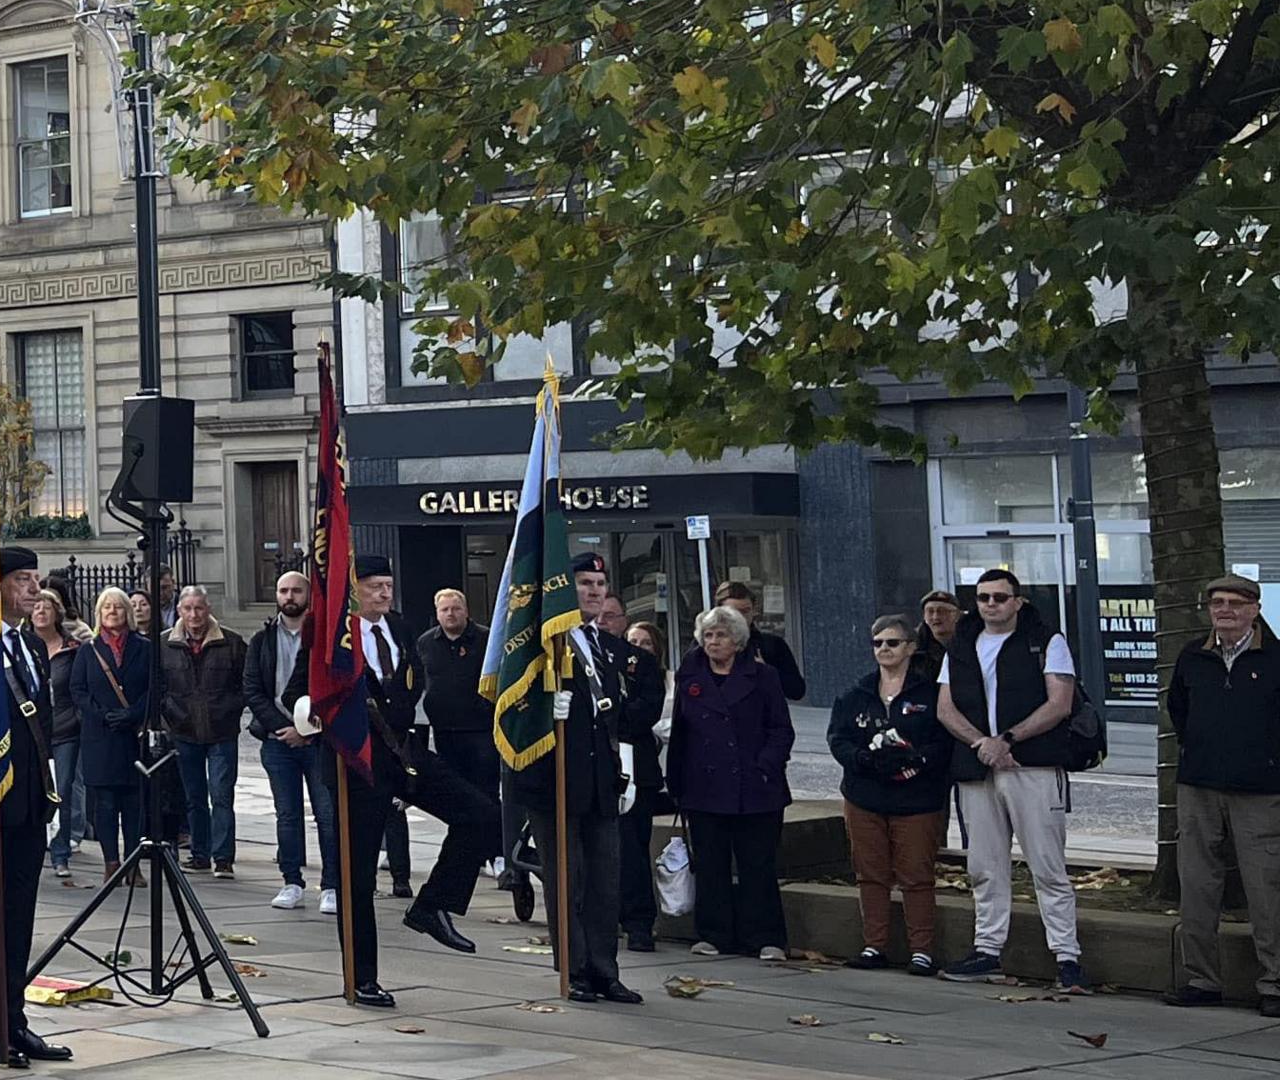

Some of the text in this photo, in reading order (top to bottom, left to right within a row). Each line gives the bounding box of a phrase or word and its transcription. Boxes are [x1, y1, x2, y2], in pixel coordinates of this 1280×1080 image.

[419, 490, 520, 515] GALLER
[542, 573, 570, 593] NCH
[1099, 599, 1156, 617] ARTIAL
[1110, 618, 1132, 632] ALL
[504, 624, 535, 655] DIST
[1146, 673, 1158, 684] 32
